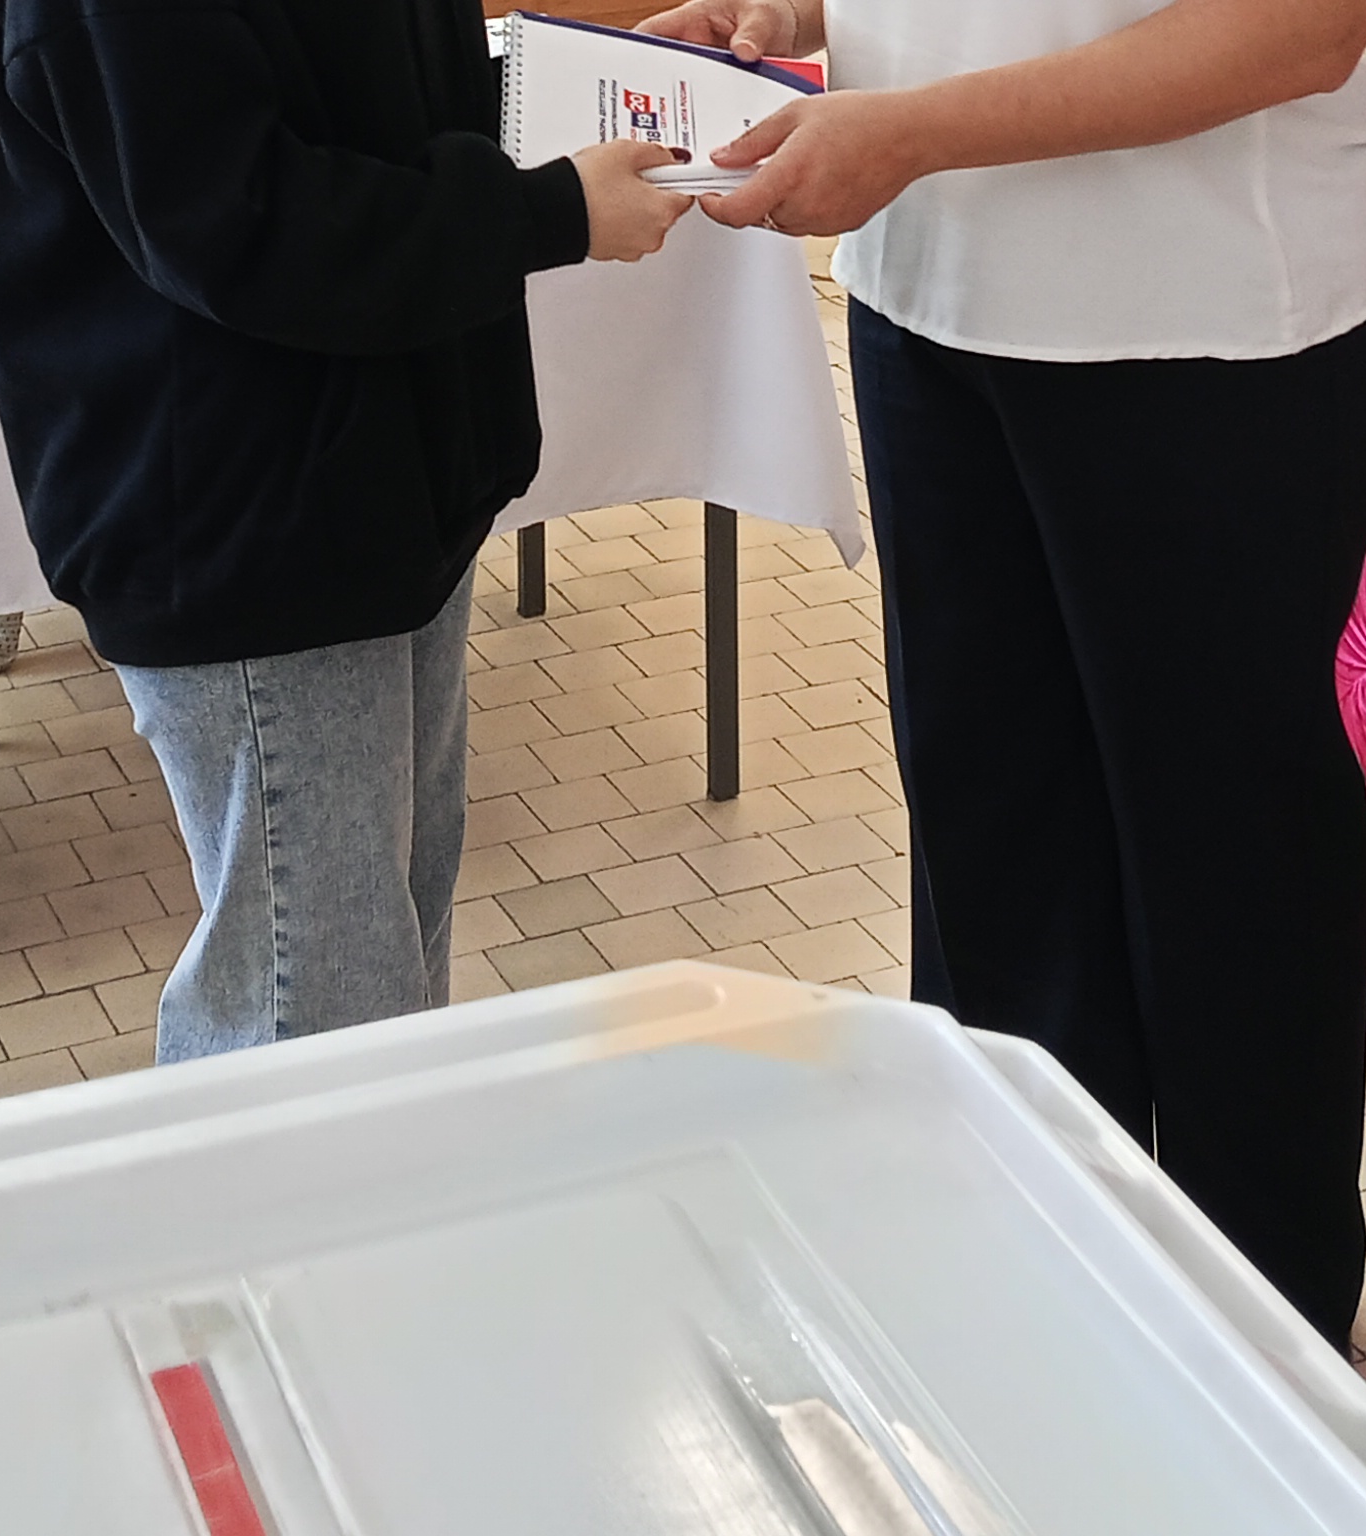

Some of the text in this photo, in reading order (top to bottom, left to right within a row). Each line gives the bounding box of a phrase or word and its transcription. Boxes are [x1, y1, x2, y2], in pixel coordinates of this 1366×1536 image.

[629, 94, 662, 143] 18 19 20
